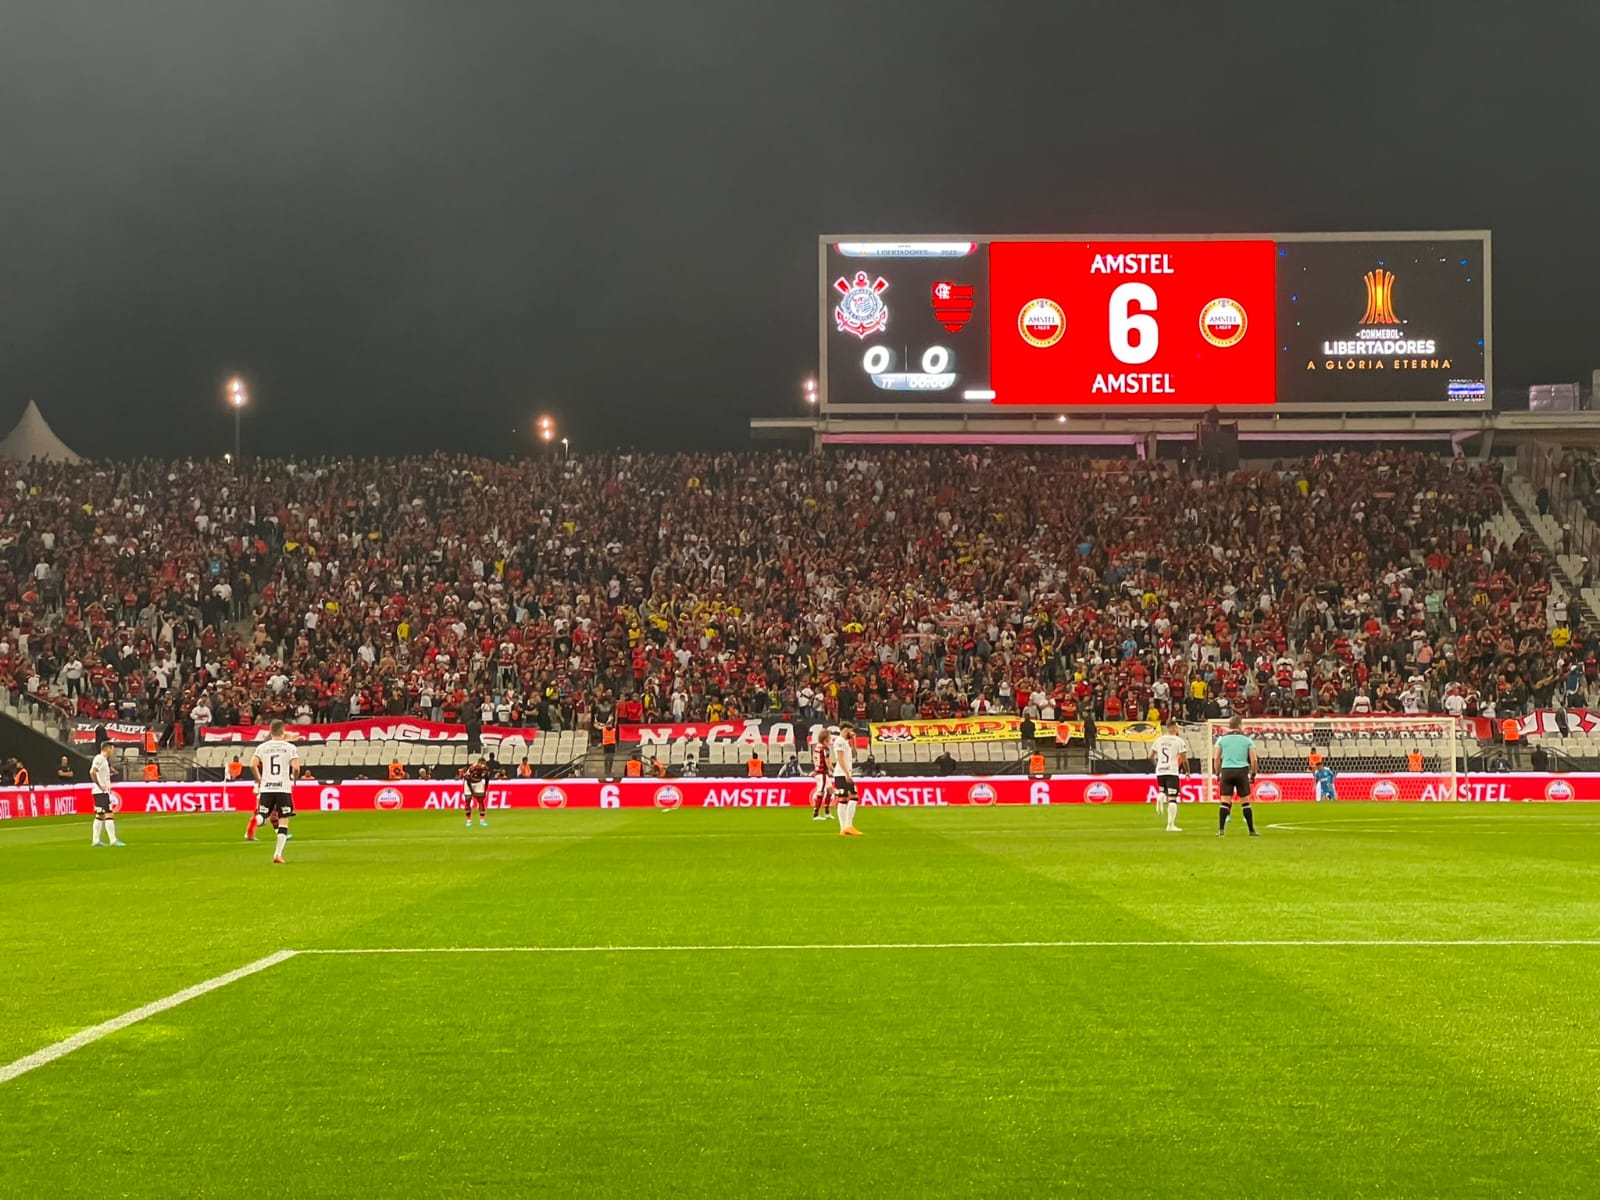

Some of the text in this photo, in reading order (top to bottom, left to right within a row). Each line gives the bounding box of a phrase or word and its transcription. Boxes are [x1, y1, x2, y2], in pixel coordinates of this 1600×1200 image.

[1090, 253, 1175, 274] AMSTEL
[1108, 281, 1159, 365] 6
[1360, 329, 1400, 340] CONMEBOL
[1324, 340, 1436, 355] LIBERTADORES
[863, 345, 949, 374] 0 0
[1307, 358, 1452, 370] A GLÓRIA ETERNA
[1091, 373, 1176, 394] AMSTEL
[270, 754, 281, 776] 6
[1161, 747, 1170, 764] 5
[145, 792, 236, 812] AMSTEL
[320, 787, 341, 811] 6
[424, 791, 512, 810] AMSEL
[600, 785, 621, 808] 6
[703, 788, 791, 807] AMSTEL
[861, 787, 949, 806] AMSTEL
[1030, 781, 1050, 805] 6
[1421, 783, 1512, 802] AMSTEL
